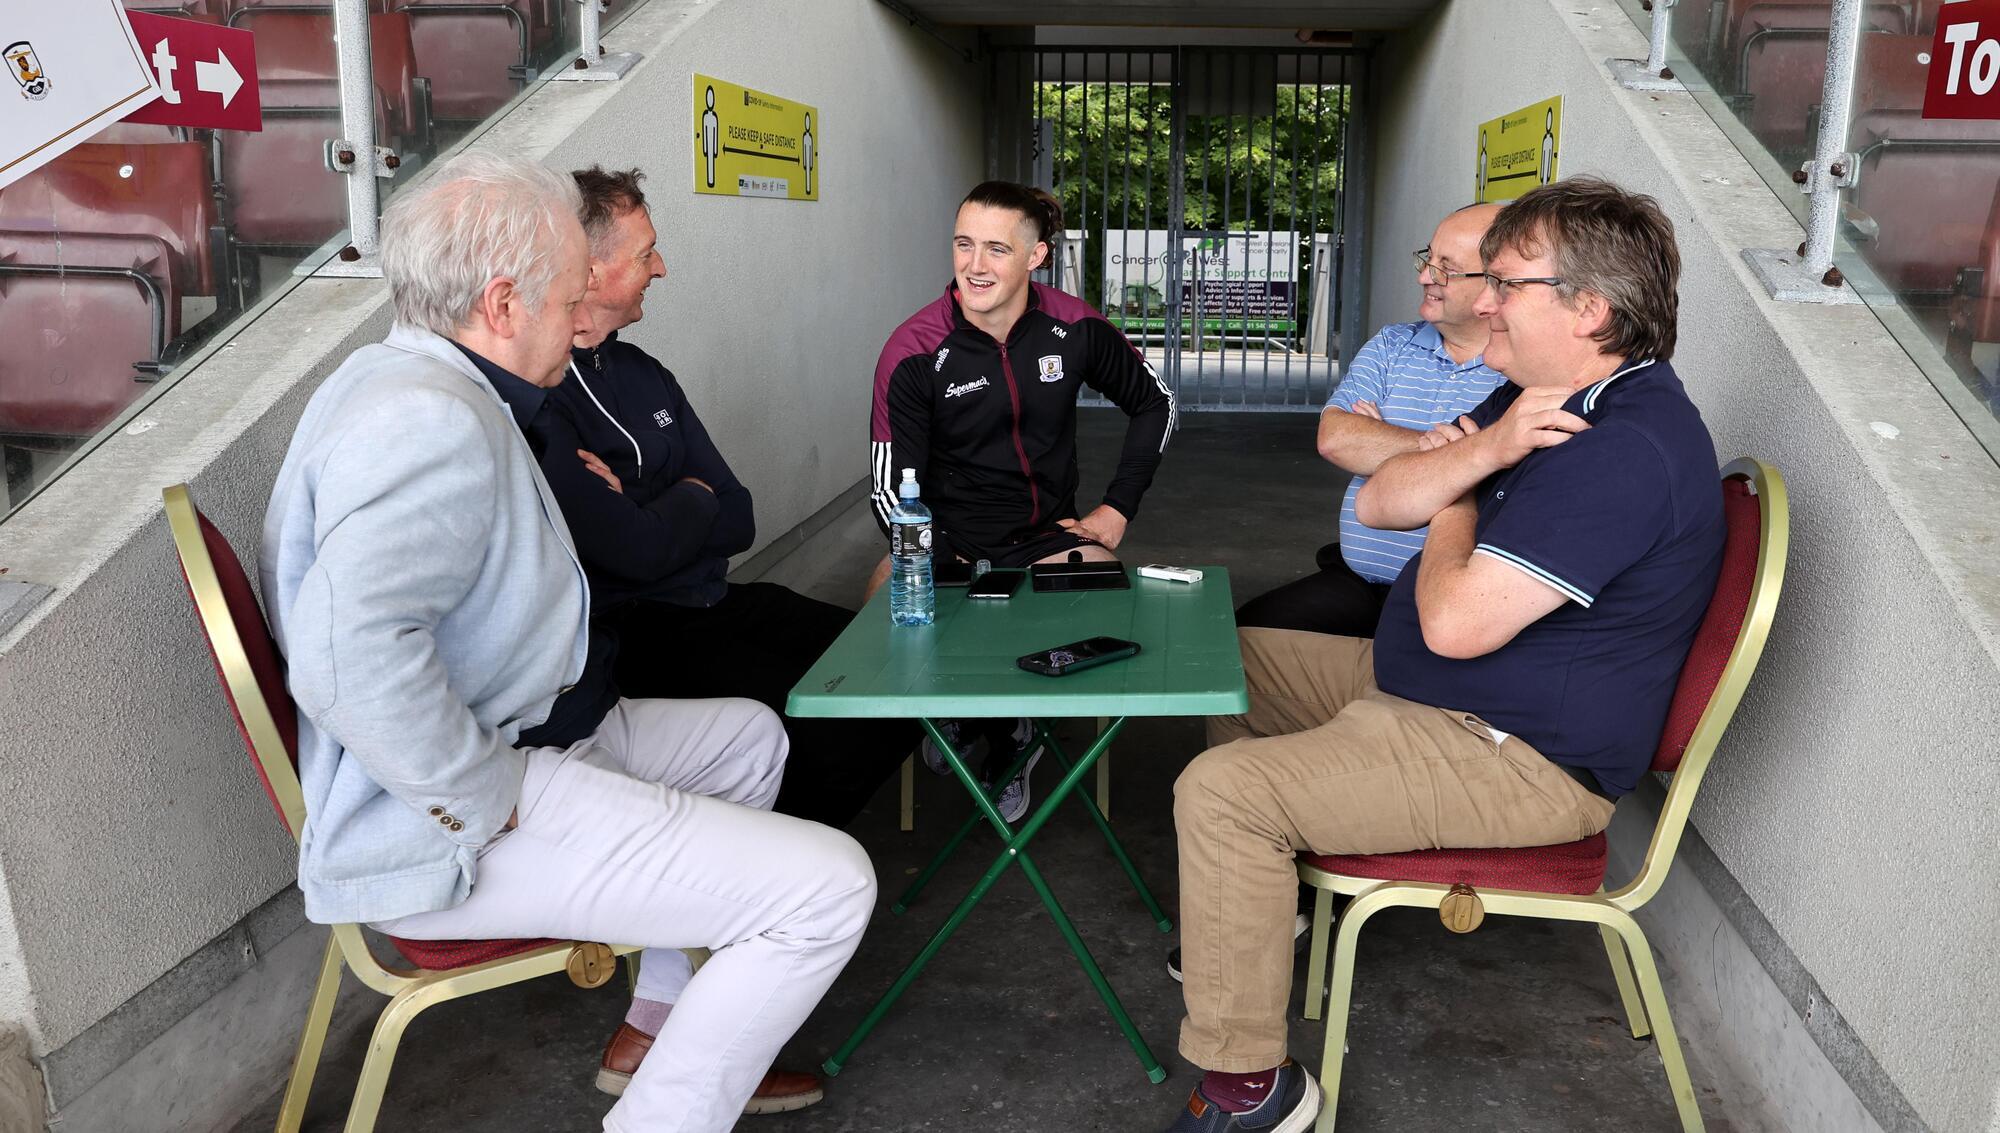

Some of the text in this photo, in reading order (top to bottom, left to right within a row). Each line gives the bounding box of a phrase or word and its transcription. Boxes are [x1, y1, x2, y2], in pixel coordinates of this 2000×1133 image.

[728, 125, 795, 149] PLEASE KEEP A SAFE DISTANCE
[1051, 325, 1067, 339] KM
